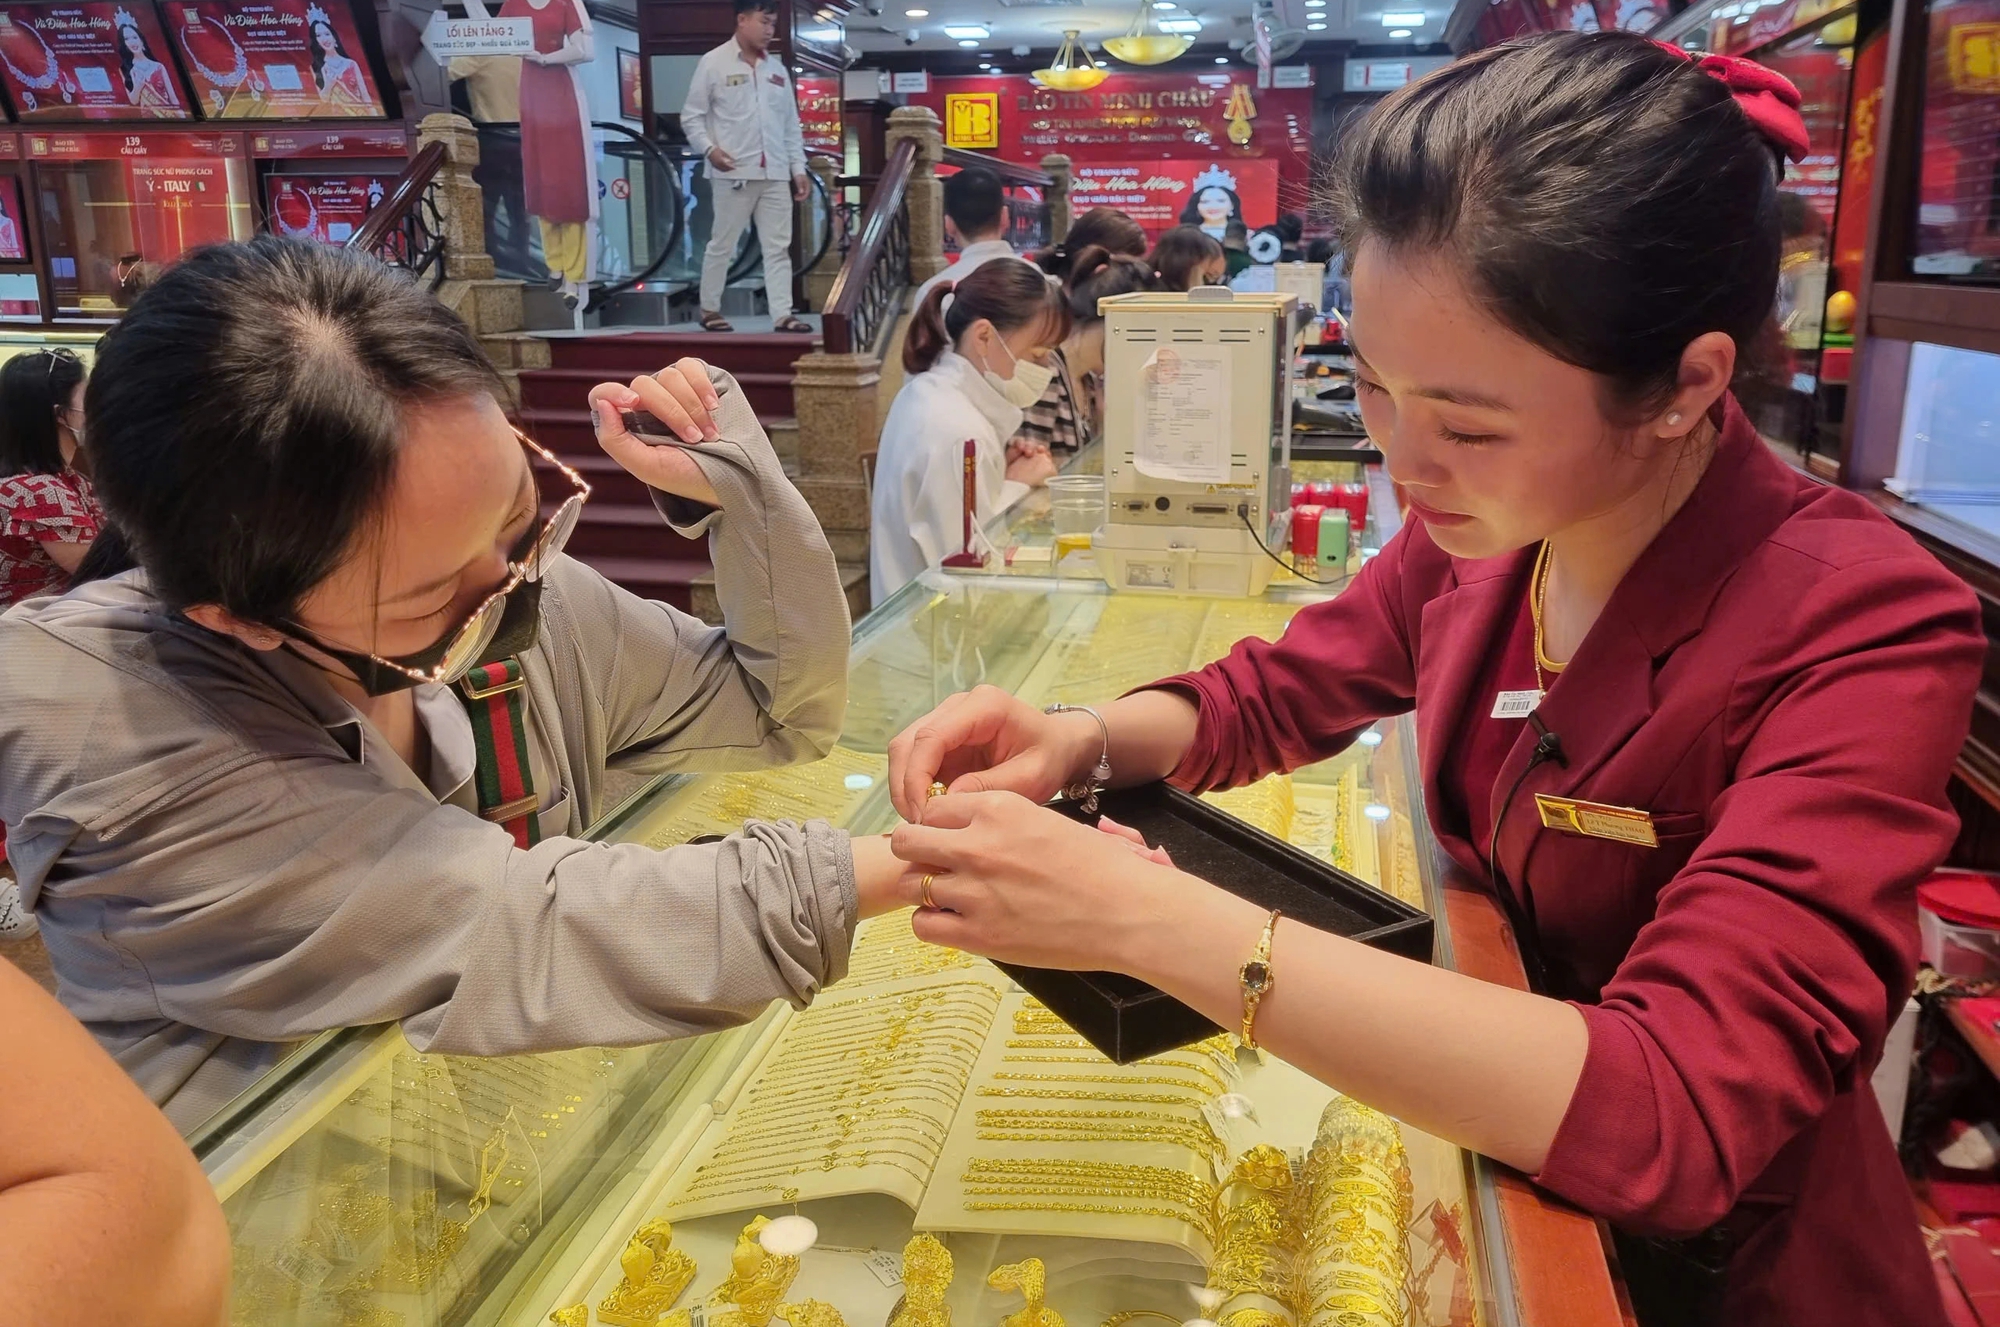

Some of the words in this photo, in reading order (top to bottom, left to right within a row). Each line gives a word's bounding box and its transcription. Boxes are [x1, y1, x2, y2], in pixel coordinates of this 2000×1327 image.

[69, 16, 88, 28] Hoa
[258, 13, 278, 26] Hoa
[279, 12, 304, 26] Hồng
[446, 24, 460, 38] LỐI
[463, 25, 478, 37] LÊN
[480, 22, 506, 36] TẦNG
[508, 26, 514, 36] 2
[1100, 92, 1153, 109] MINH
[1158, 87, 1214, 108] CHÂU
[126, 136, 140, 146] 139
[146, 177, 154, 192] Ý
[164, 180, 191, 192] ITALY
